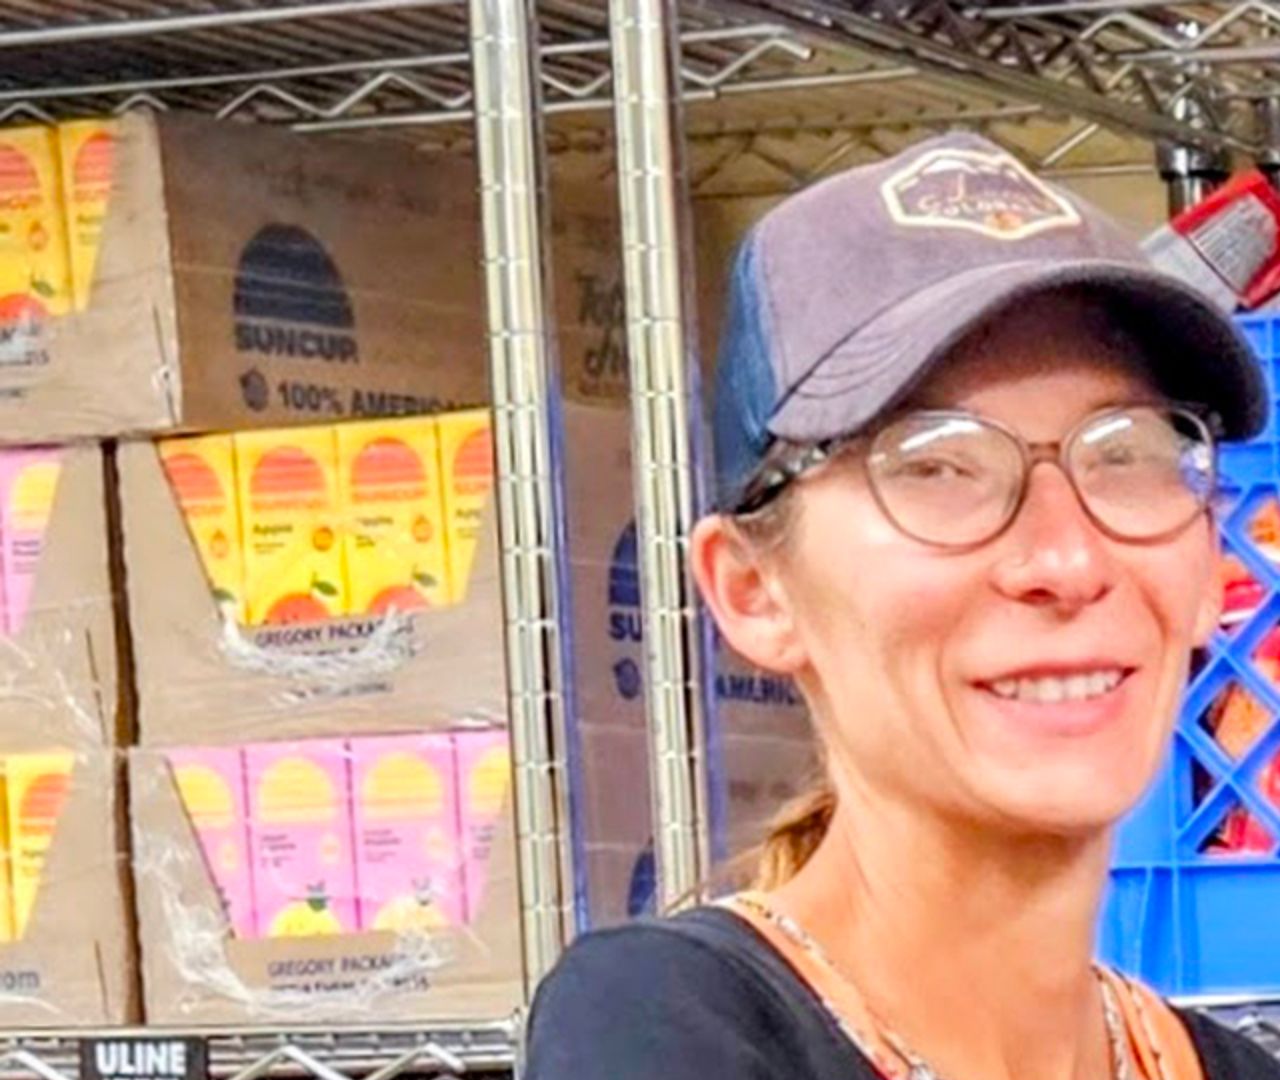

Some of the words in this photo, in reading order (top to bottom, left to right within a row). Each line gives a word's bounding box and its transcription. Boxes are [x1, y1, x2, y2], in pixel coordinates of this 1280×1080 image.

[235, 322, 359, 364] SUNCUP
[276, 380, 343, 414] 100%
[256, 624, 322, 648] GREGORY
[267, 956, 335, 978] GREGORY
[95, 1041, 187, 1076] ULINE
